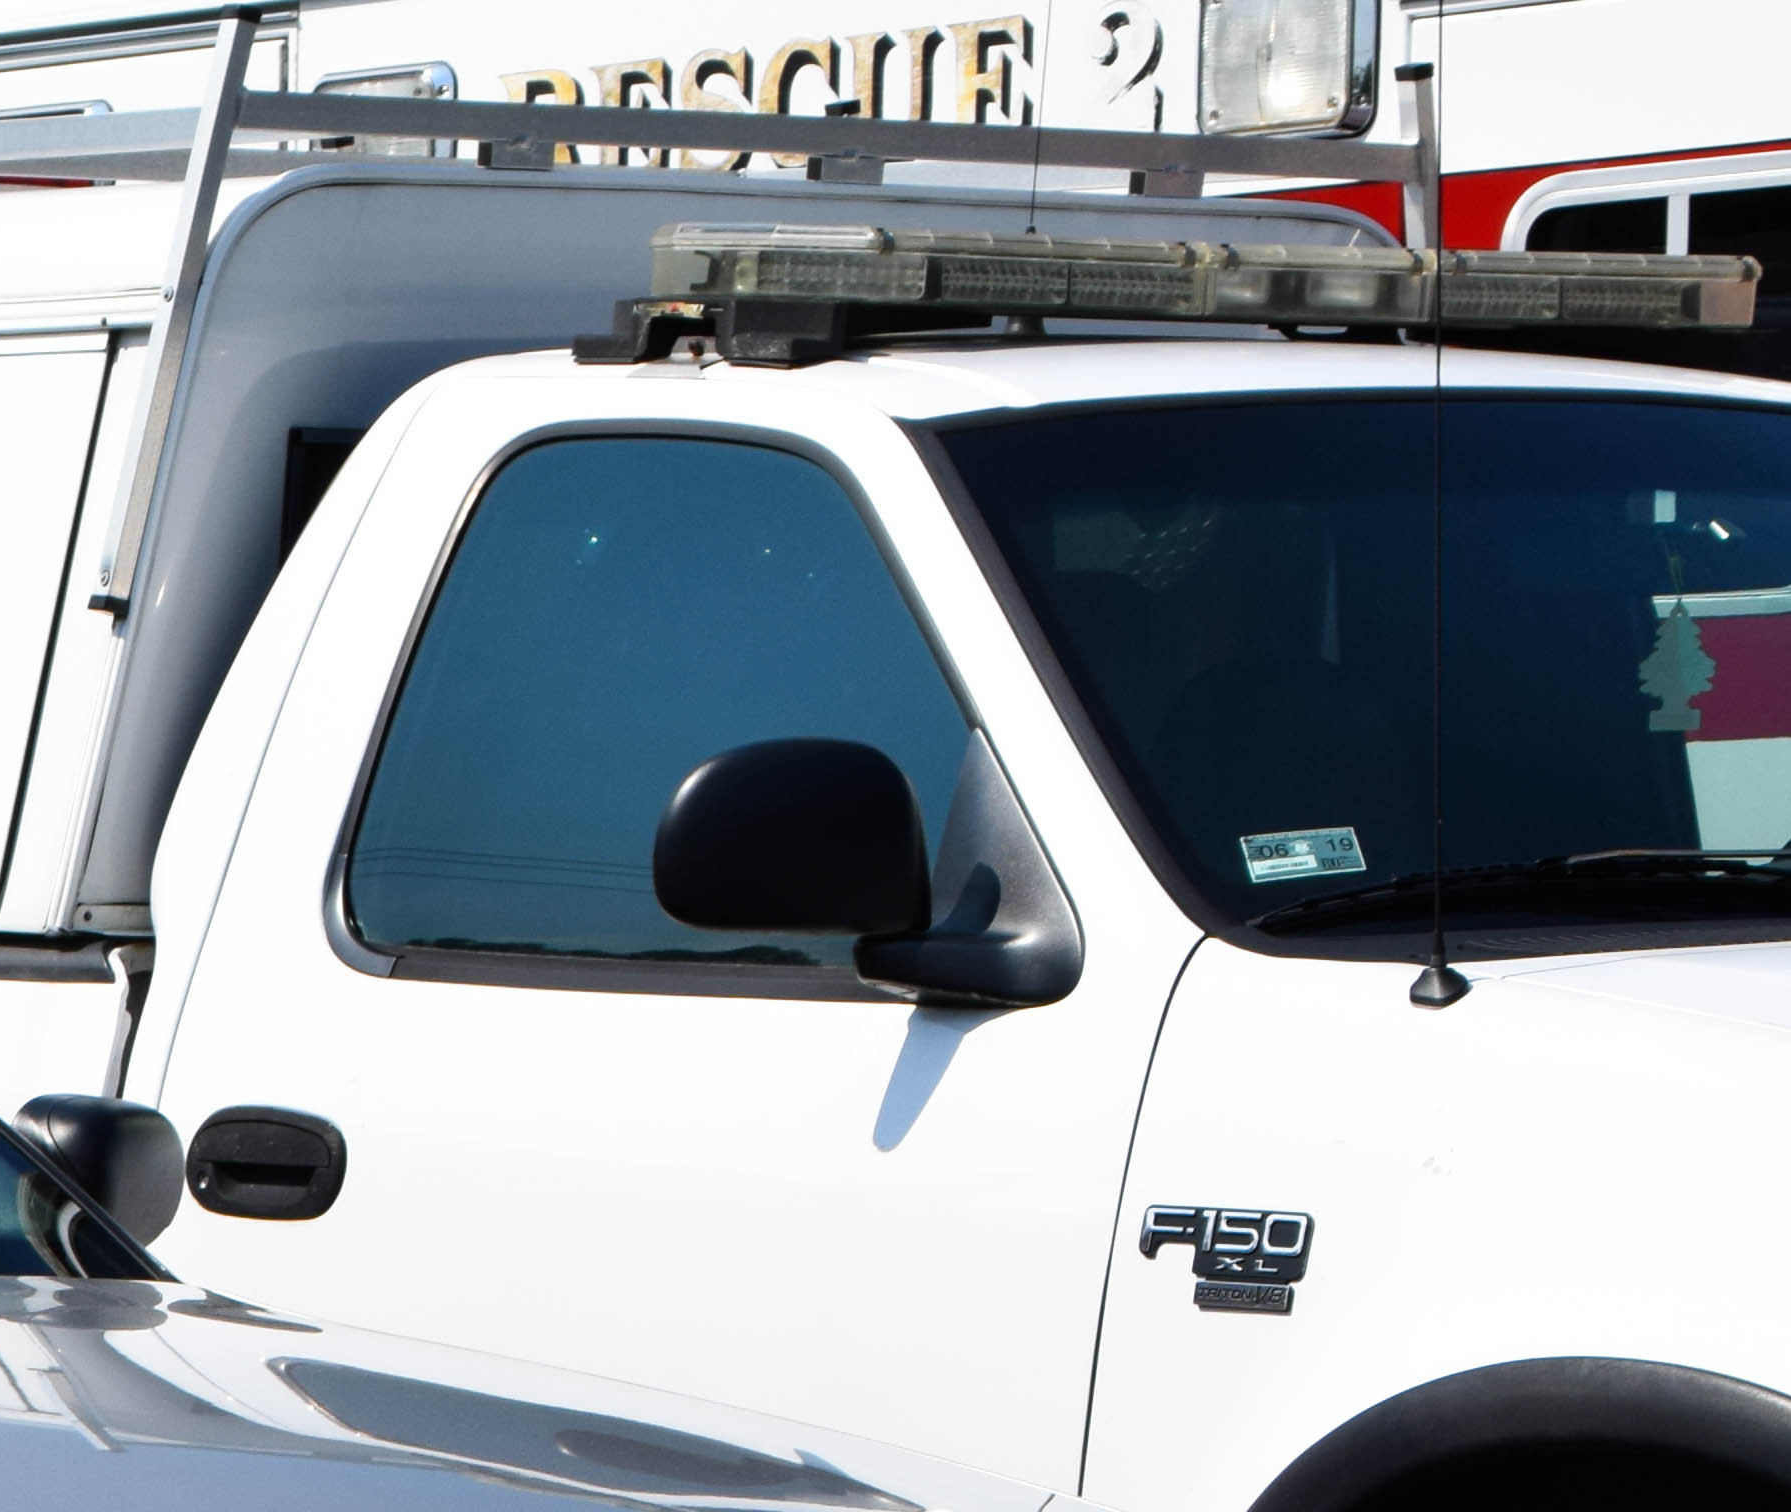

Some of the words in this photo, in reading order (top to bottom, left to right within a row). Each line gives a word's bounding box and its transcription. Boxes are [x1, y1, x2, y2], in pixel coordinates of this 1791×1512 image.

[500, 14, 1034, 174] RESCUE
[1259, 843, 1289, 859] 06
[1326, 837, 1354, 852] 19
[1140, 1207, 1309, 1257] F-150
[1197, 1286, 1251, 1301] TRITON
[1254, 1287, 1285, 1304] V8
